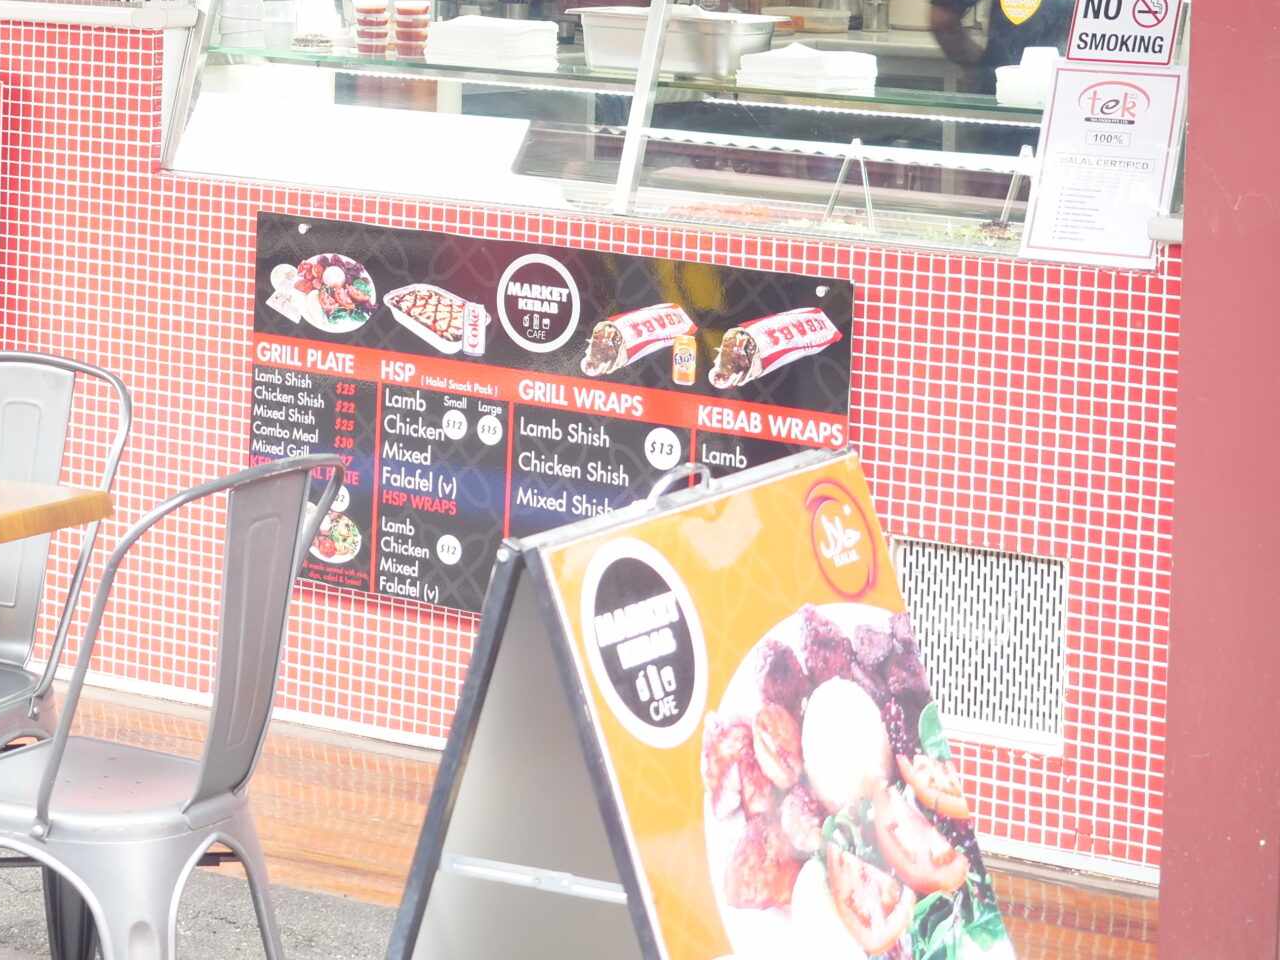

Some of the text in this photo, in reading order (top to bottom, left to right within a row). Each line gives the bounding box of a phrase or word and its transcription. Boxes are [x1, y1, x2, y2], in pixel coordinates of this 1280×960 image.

[1076, 31, 1164, 55] SMOKING
[1087, 89, 1137, 119] tek
[507, 281, 569, 302] MARKET
[518, 298, 559, 315] KEBAB
[526, 329, 546, 340] CAFE
[256, 342, 355, 374] GRILL PLATE
[384, 391, 426, 412] Lamb
[518, 379, 644, 417] GRILL WRAPS
[519, 416, 611, 449] Lamb Shish
[697, 405, 844, 446] KEBAB WRAPS
[382, 442, 432, 466] Mixed
[701, 444, 748, 469] Lamb
[518, 451, 630, 488] Chicken Shish
[382, 467, 433, 492] Falafel
[437, 474, 457, 499] (v)
[381, 515, 415, 536] Lamb
[379, 557, 419, 578] Mixed
[379, 577, 439, 603] Falafel (v)
[649, 694, 680, 722] CAFE
